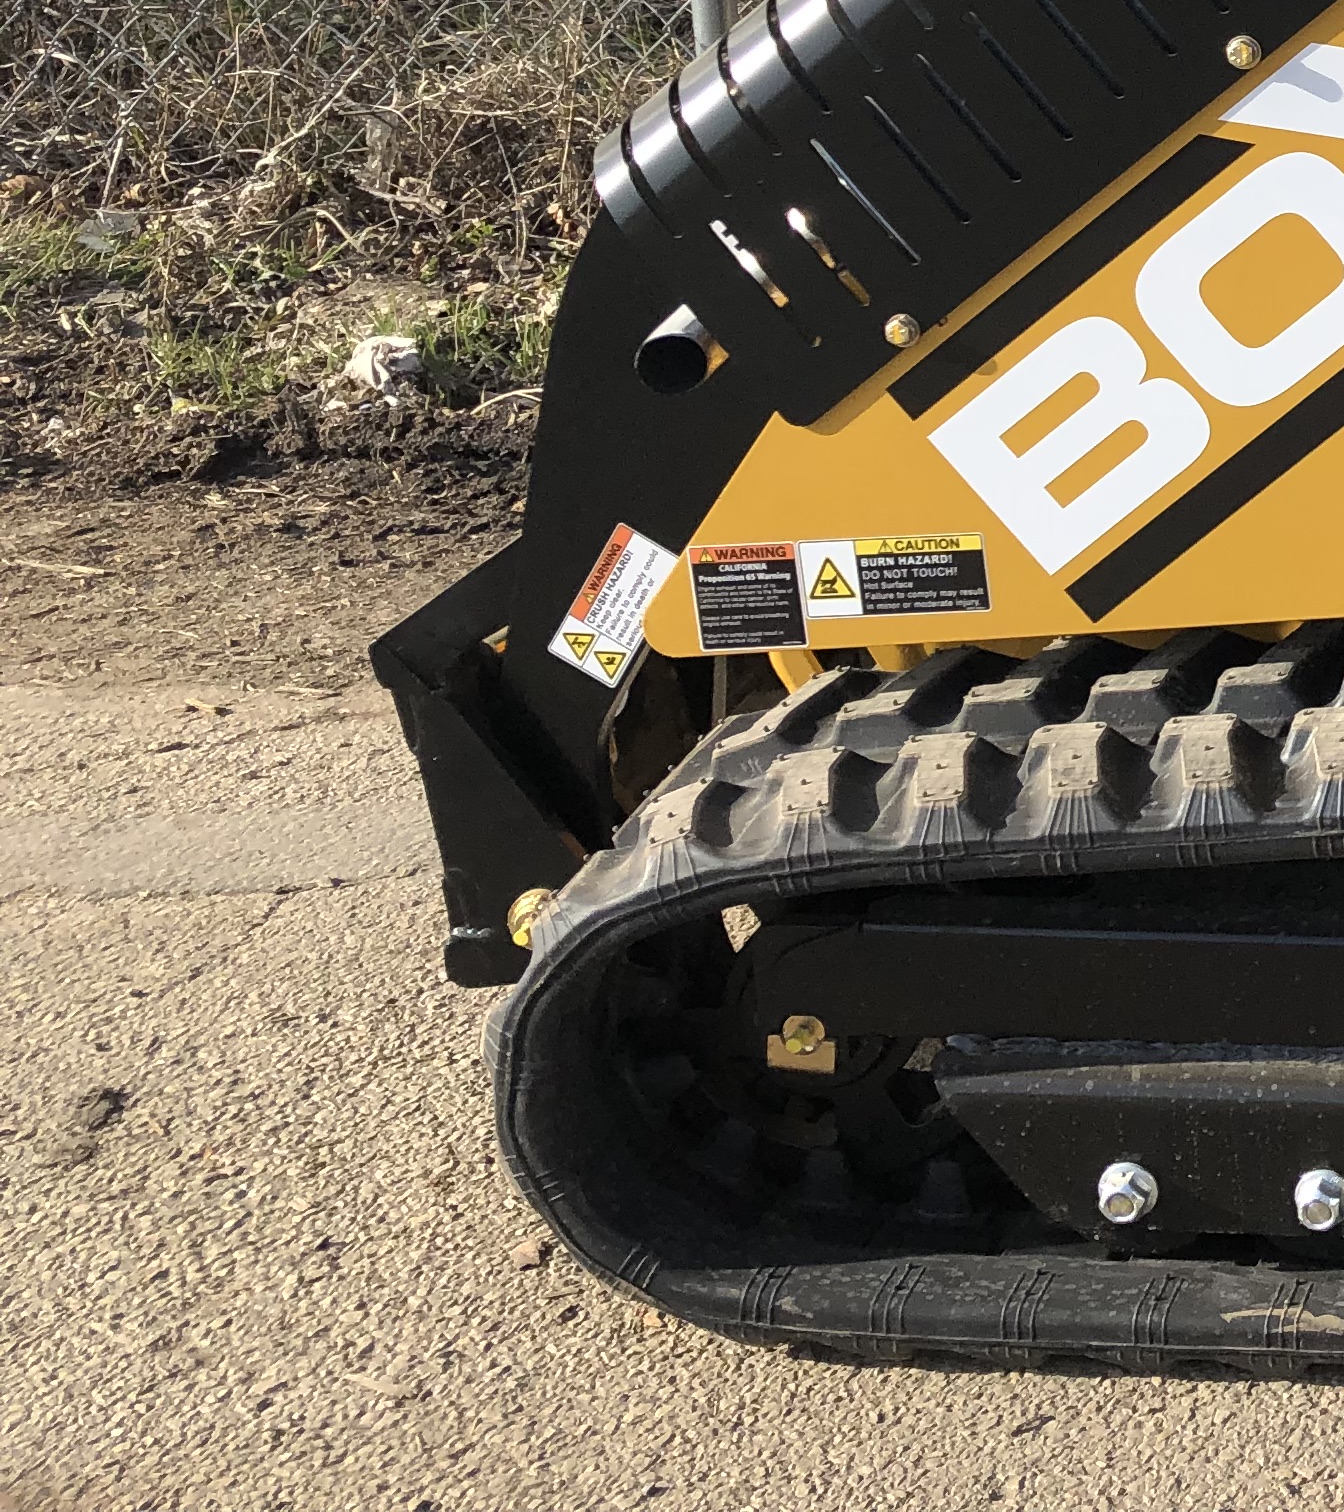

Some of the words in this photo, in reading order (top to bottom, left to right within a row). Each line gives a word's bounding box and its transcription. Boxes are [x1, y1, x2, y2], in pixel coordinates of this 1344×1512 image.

[894, 539, 960, 551] CAUTION
[714, 546, 787, 560] WARNING
[587, 543, 622, 591] WARNING
[718, 563, 767, 572] CALIFORNIA
[860, 557, 895, 567] BURN
[898, 555, 952, 565] HAZARD!
[862, 570, 880, 580] DO
[884, 569, 908, 578] NOT
[912, 567, 958, 577] TOUCH!
[604, 609, 624, 635] Failure
[620, 599, 630, 608] to
[627, 571, 646, 598] comply
[643, 548, 658, 570] could
[865, 592, 894, 600] Failure
[907, 590, 937, 598] comply
[940, 589, 957, 598] may
[586, 591, 609, 623] CRUSH
[595, 609, 611, 629] Keep
[608, 588, 624, 608] clear.
[615, 618, 632, 641] result
[627, 610, 636, 618] in
[633, 588, 649, 609] death
[647, 577, 654, 587] or
